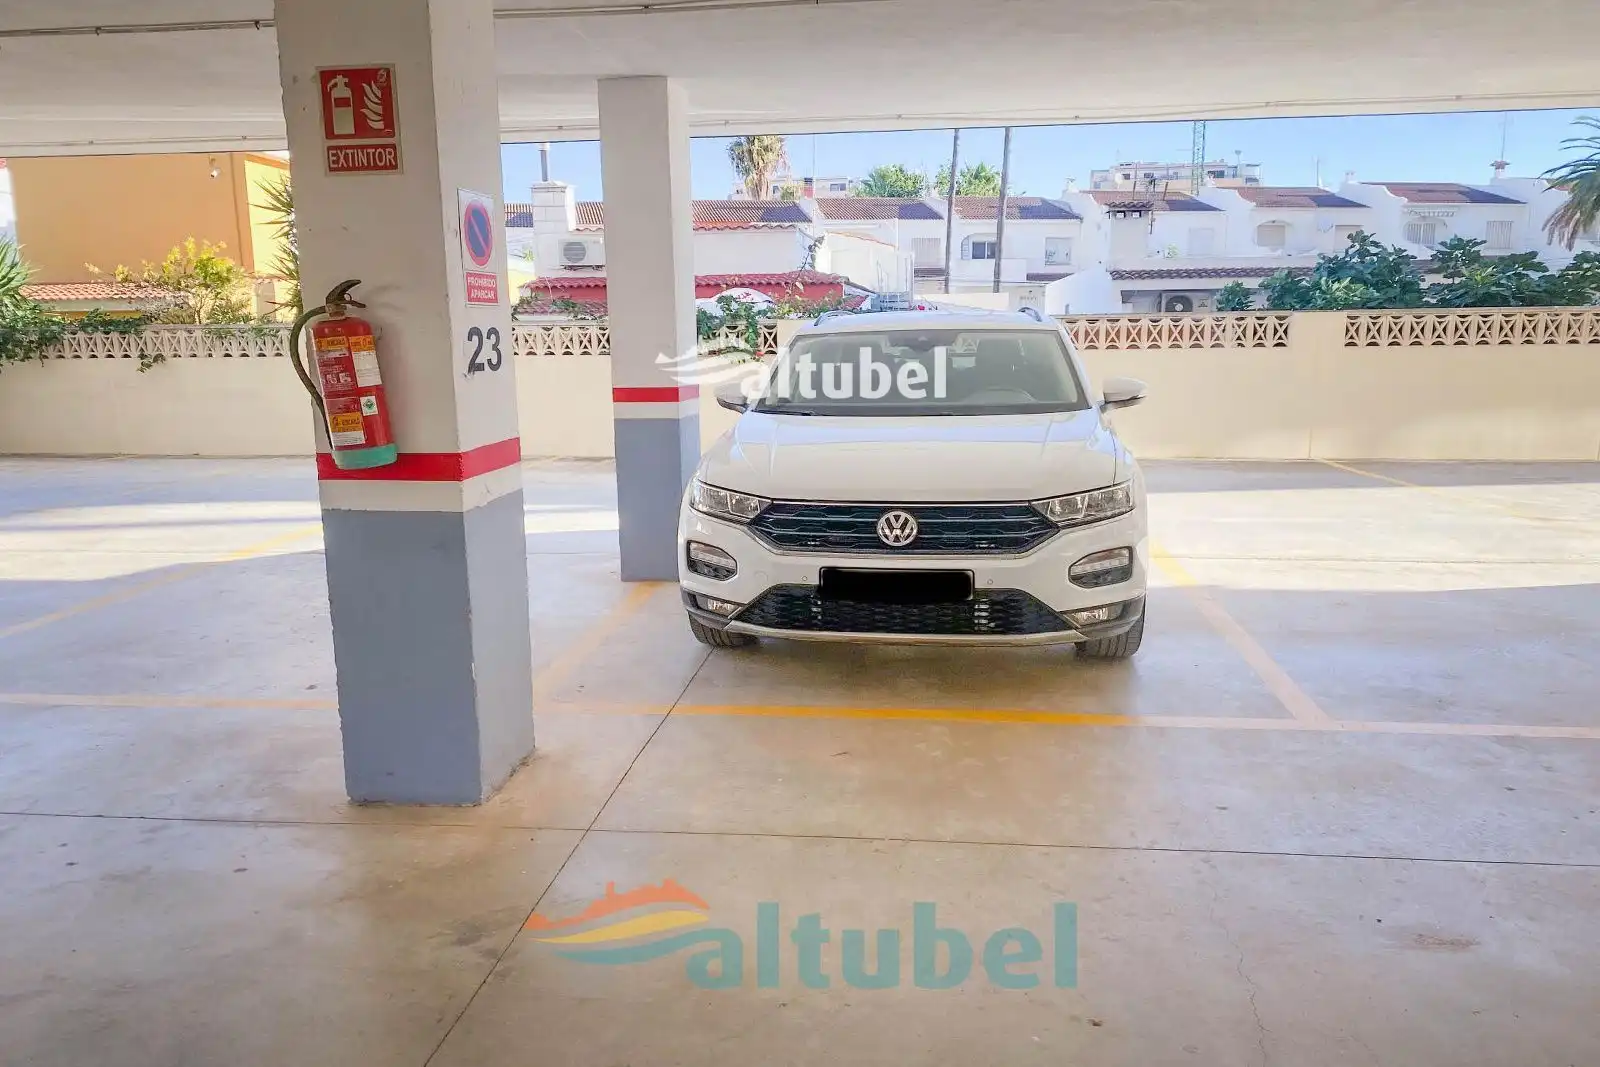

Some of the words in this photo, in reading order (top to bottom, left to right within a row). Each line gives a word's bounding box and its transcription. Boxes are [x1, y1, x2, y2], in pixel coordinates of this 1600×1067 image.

[328, 148, 396, 169] EXTINTOR
[467, 276, 496, 288] PROHIBIDO
[471, 288, 495, 299] APARCAR
[467, 326, 502, 373] 23
